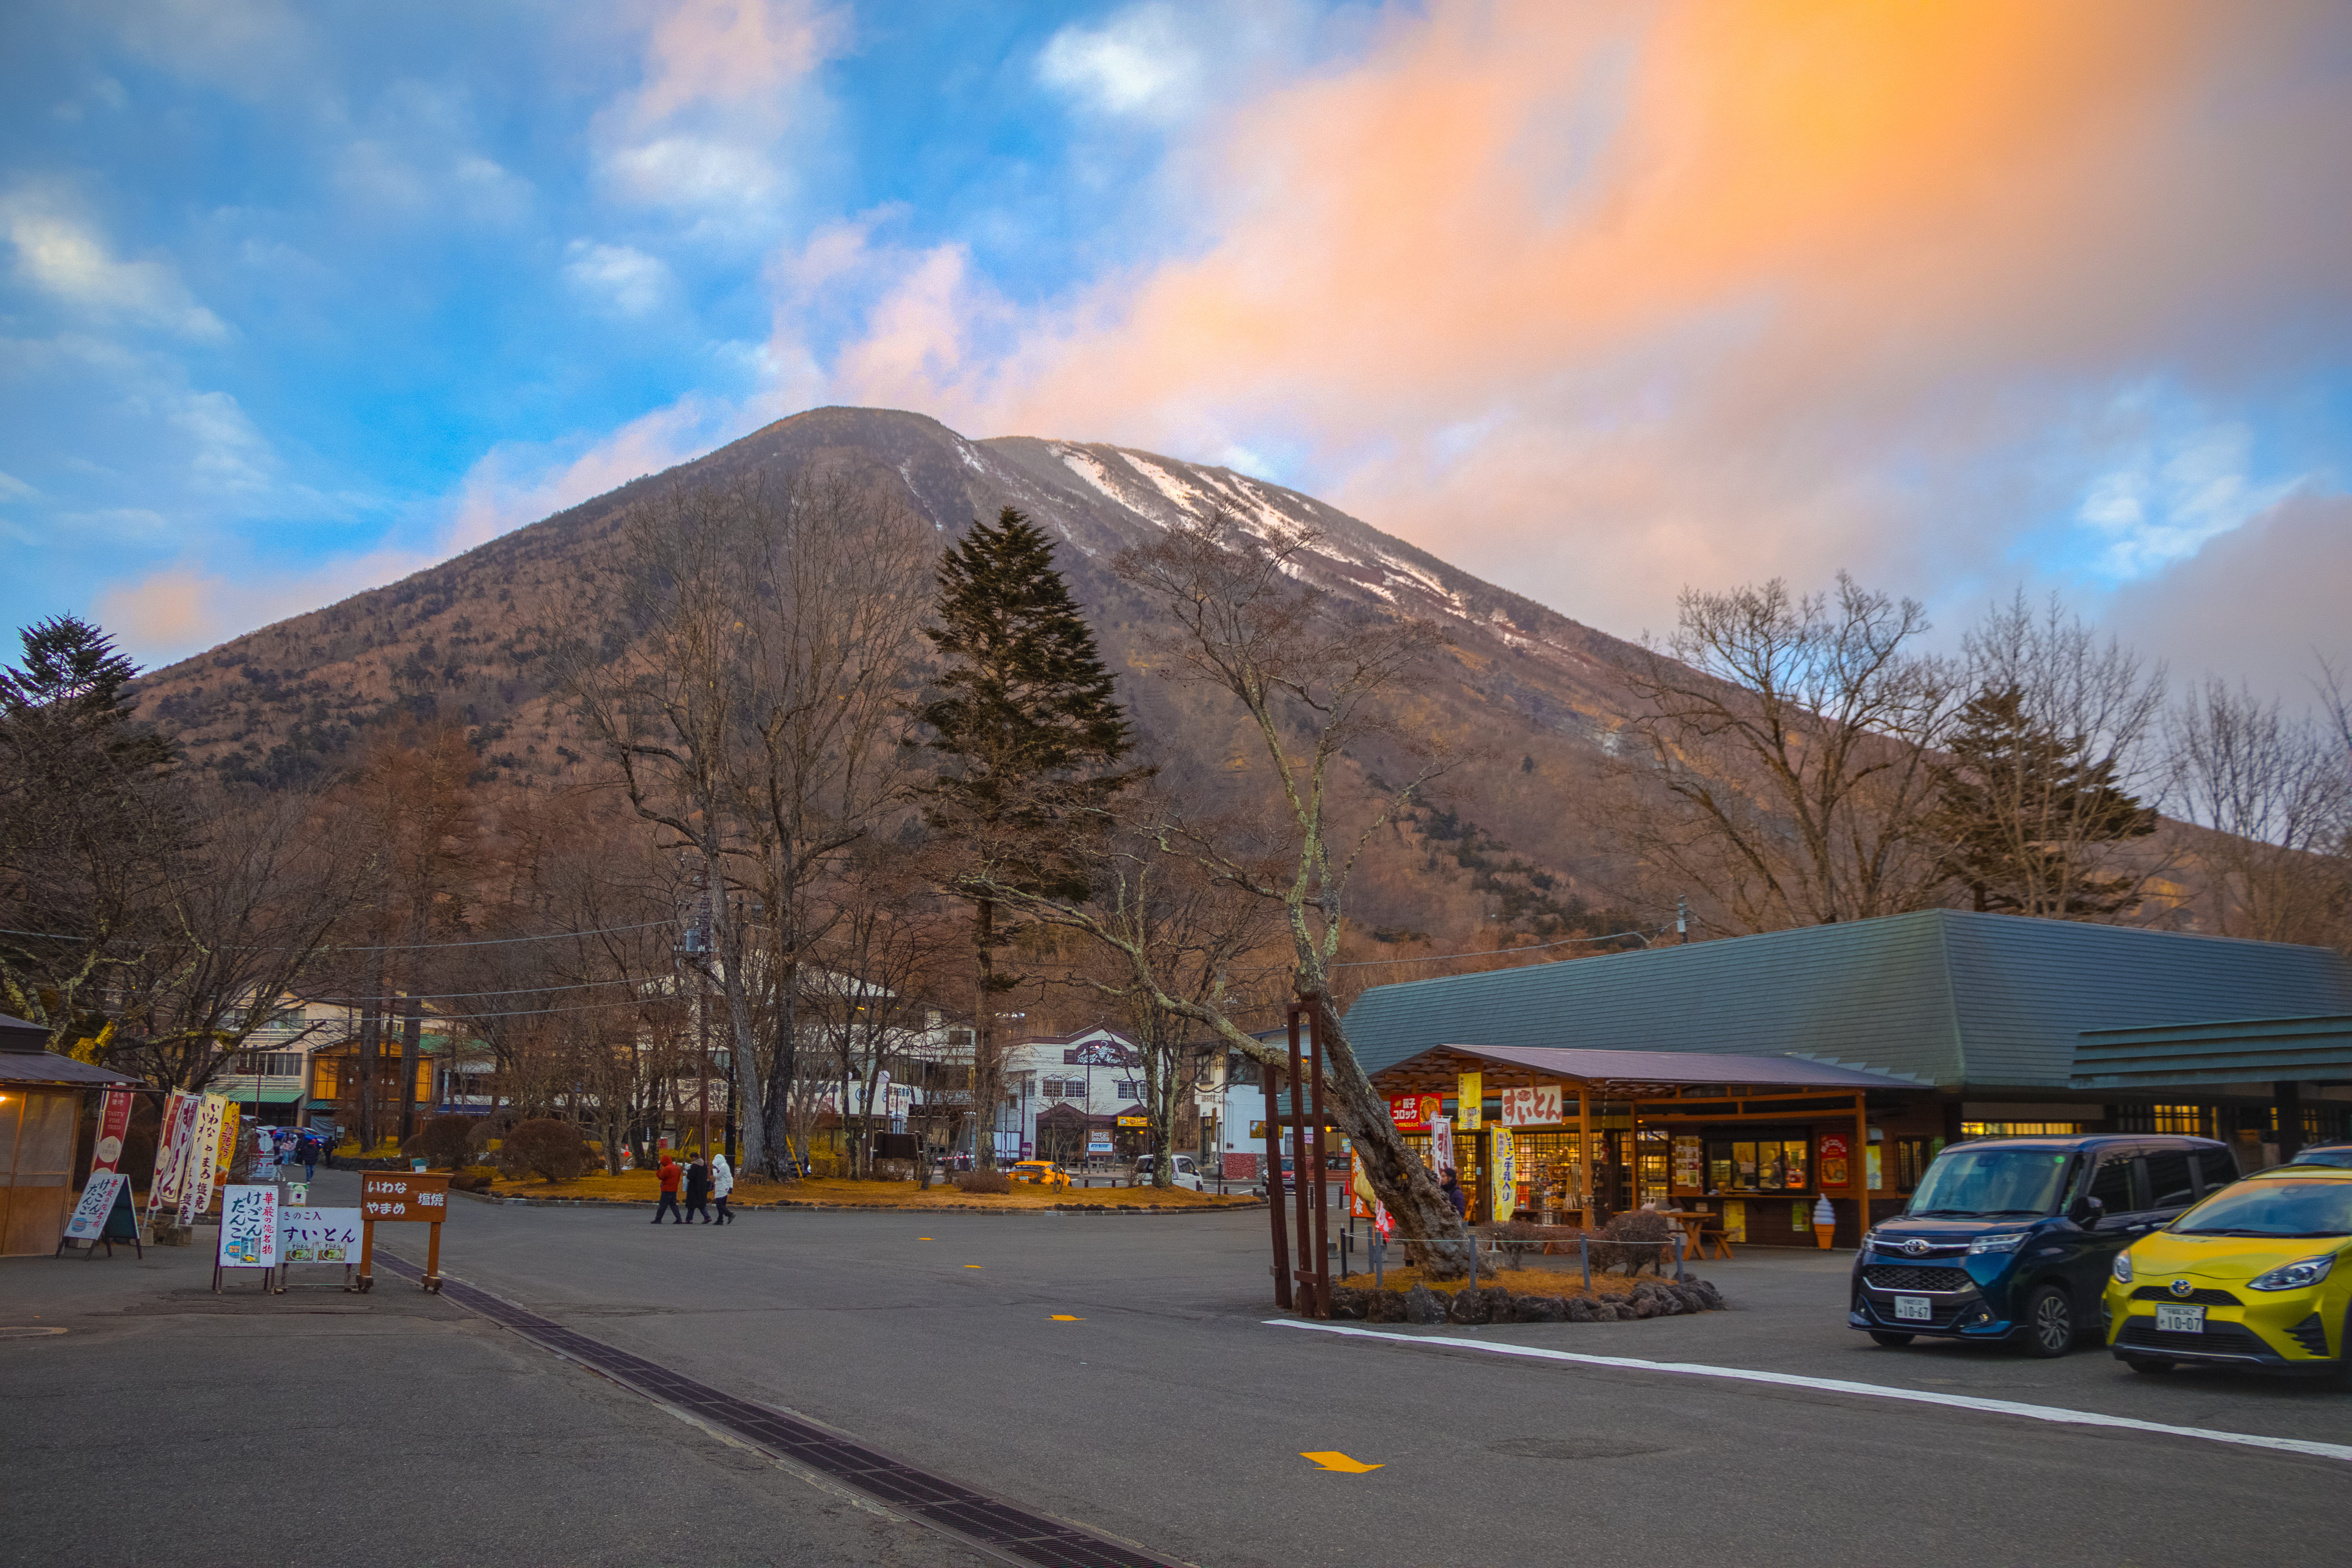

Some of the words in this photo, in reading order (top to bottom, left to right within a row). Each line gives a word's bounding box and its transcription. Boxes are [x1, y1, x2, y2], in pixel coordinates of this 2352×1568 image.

[1403, 1098, 1416, 1109] 餃子
[1504, 1087, 1563, 1125] すいとん
[1393, 1109, 1417, 1120] コロッケ
[1503, 1132, 1514, 1201] レモン牛乳入り
[368, 1181, 407, 1194] いわな
[79, 1183, 101, 1215] だんご
[89, 1179, 111, 1213] けごん
[417, 1193, 444, 1207] 塩焼
[246, 1192, 263, 1236] けごん
[367, 1202, 405, 1214] やまめ
[228, 1198, 247, 1239] だんご
[262, 1192, 276, 1255] 華厳の滝名物
[284, 1211, 322, 1221] きのこ入
[282, 1226, 356, 1243] すいとん
[1904, 1306, 1929, 1318] 10-67
[2169, 1316, 2202, 1330] 10-07
